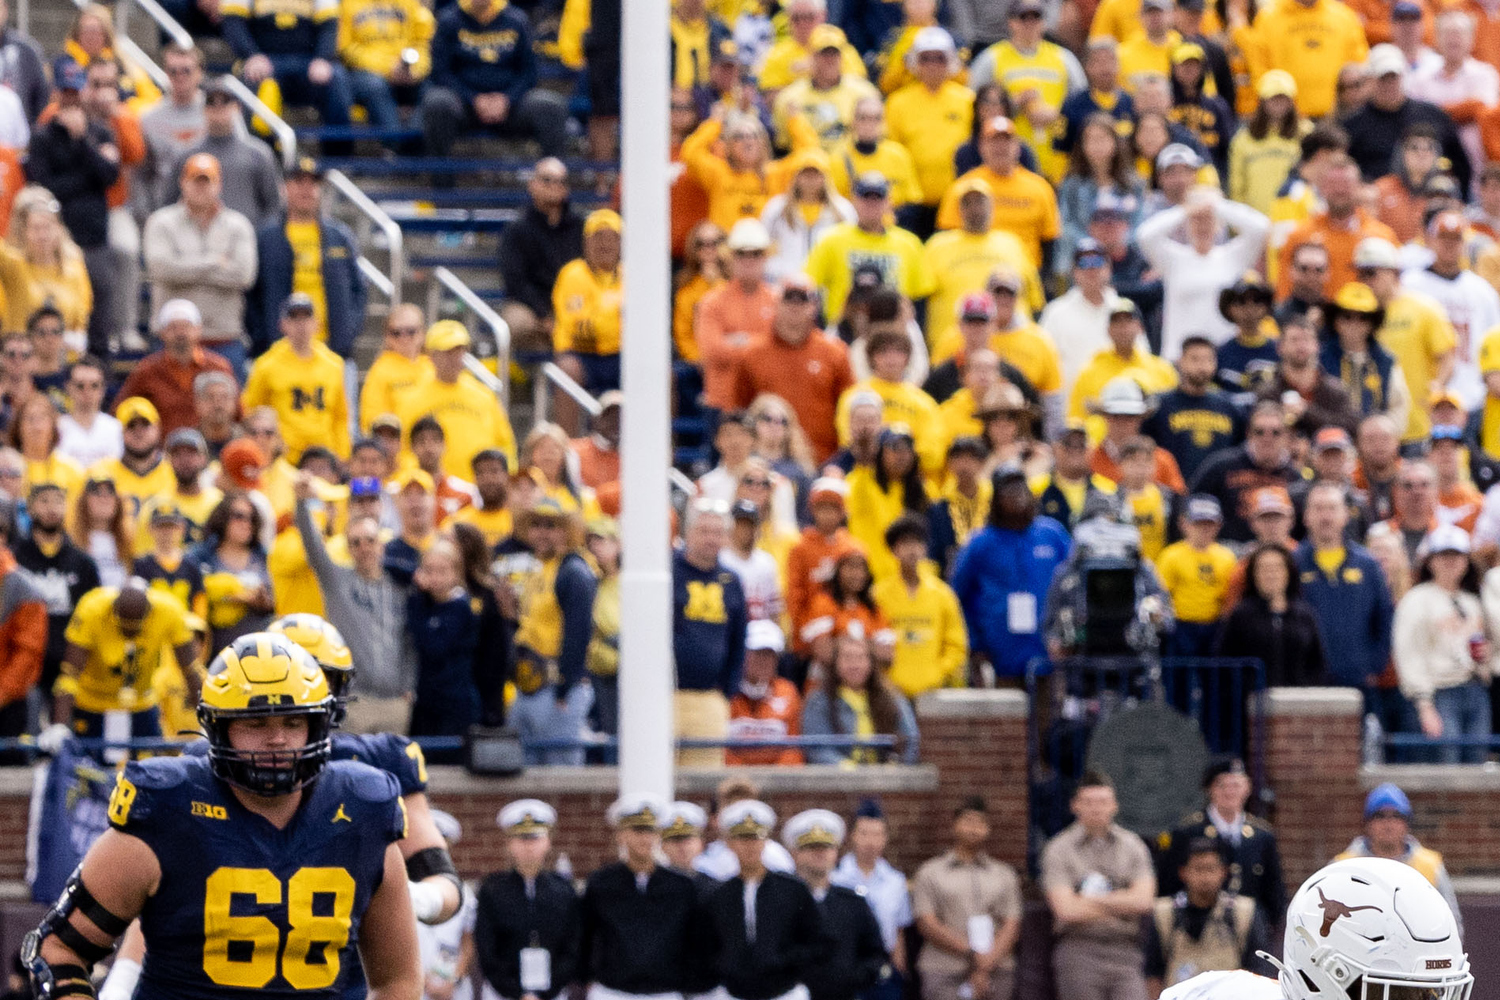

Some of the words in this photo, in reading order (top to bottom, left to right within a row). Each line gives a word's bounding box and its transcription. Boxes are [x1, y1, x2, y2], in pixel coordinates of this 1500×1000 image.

[291, 385, 326, 412] M
[683, 580, 728, 624] M
[202, 866, 356, 990] 68
